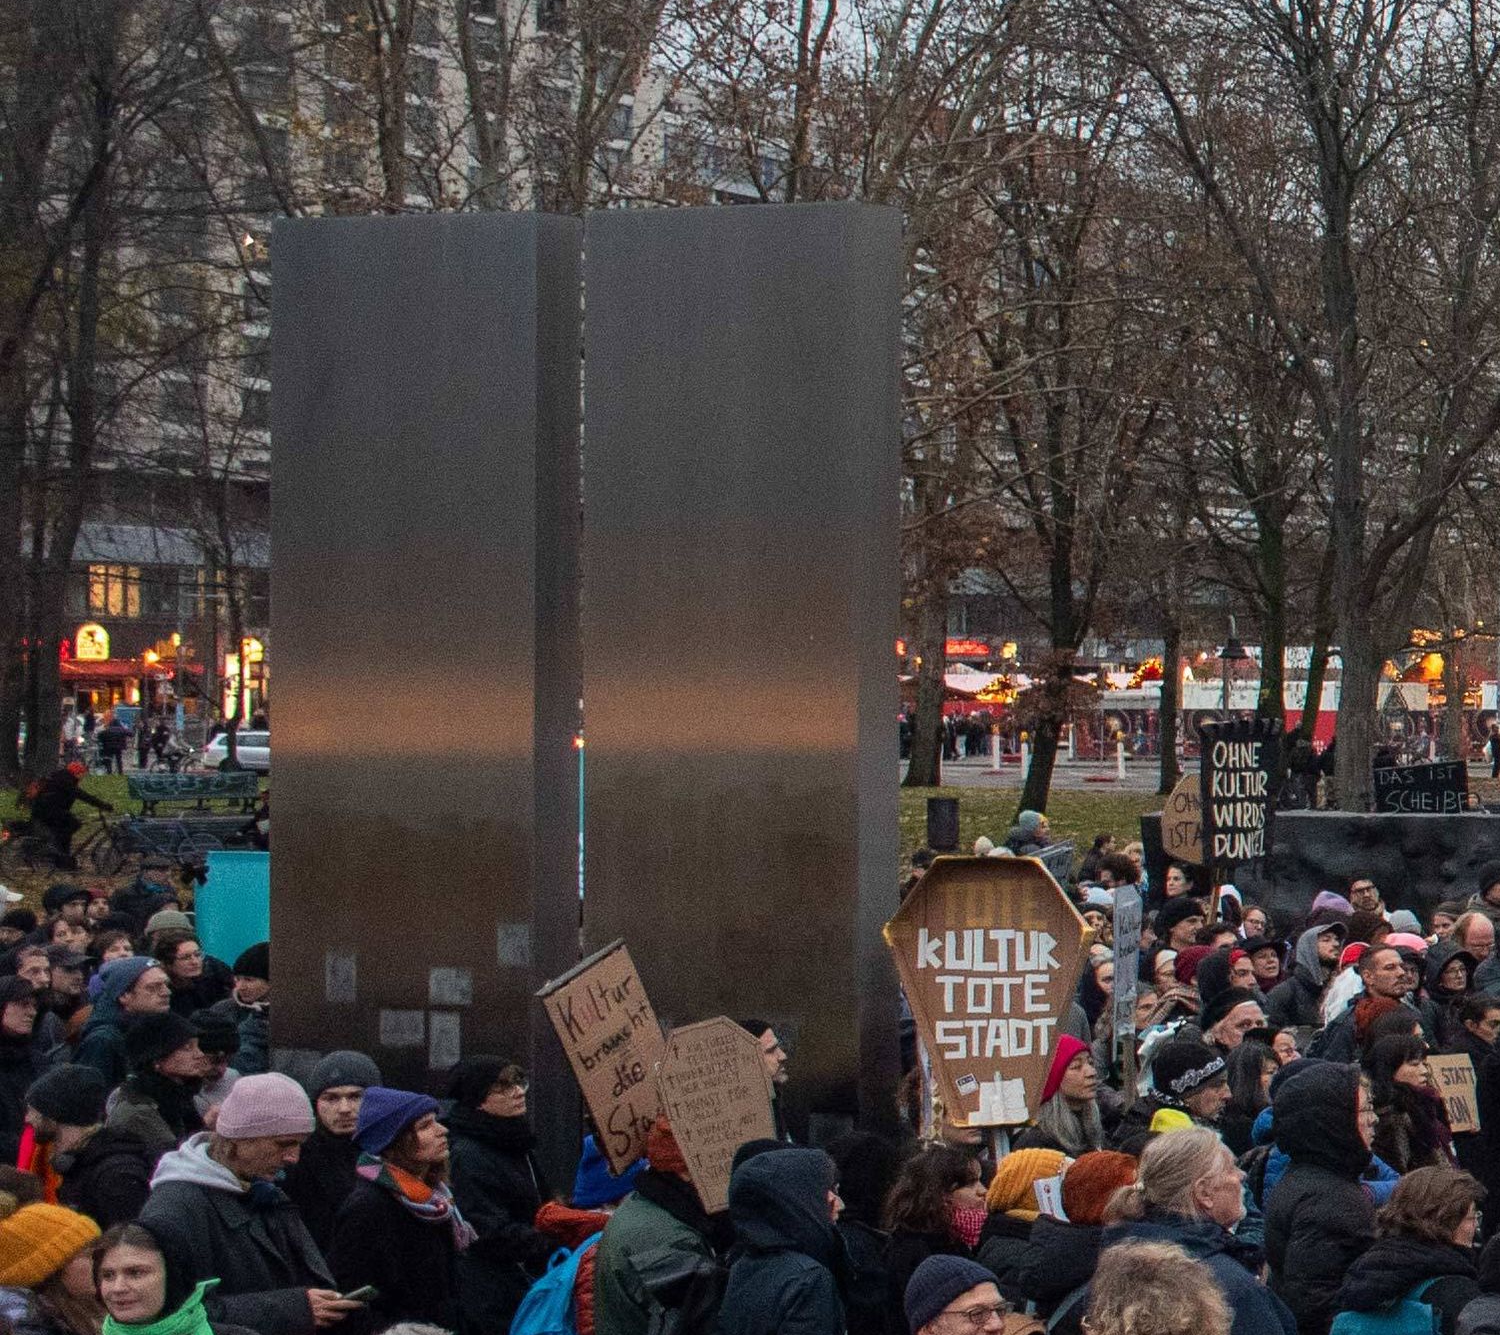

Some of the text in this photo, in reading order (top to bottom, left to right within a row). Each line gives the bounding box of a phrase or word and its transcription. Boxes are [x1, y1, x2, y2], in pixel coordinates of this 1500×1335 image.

[1212, 741, 1263, 769] OHNE
[1212, 769, 1268, 798] KULTUR
[916, 928, 1062, 973] KULTUR
[556, 975, 633, 1044] Kultur
[935, 974, 1051, 1014] TOTE
[935, 1017, 1058, 1060] STADT
[612, 1062, 646, 1099] die
